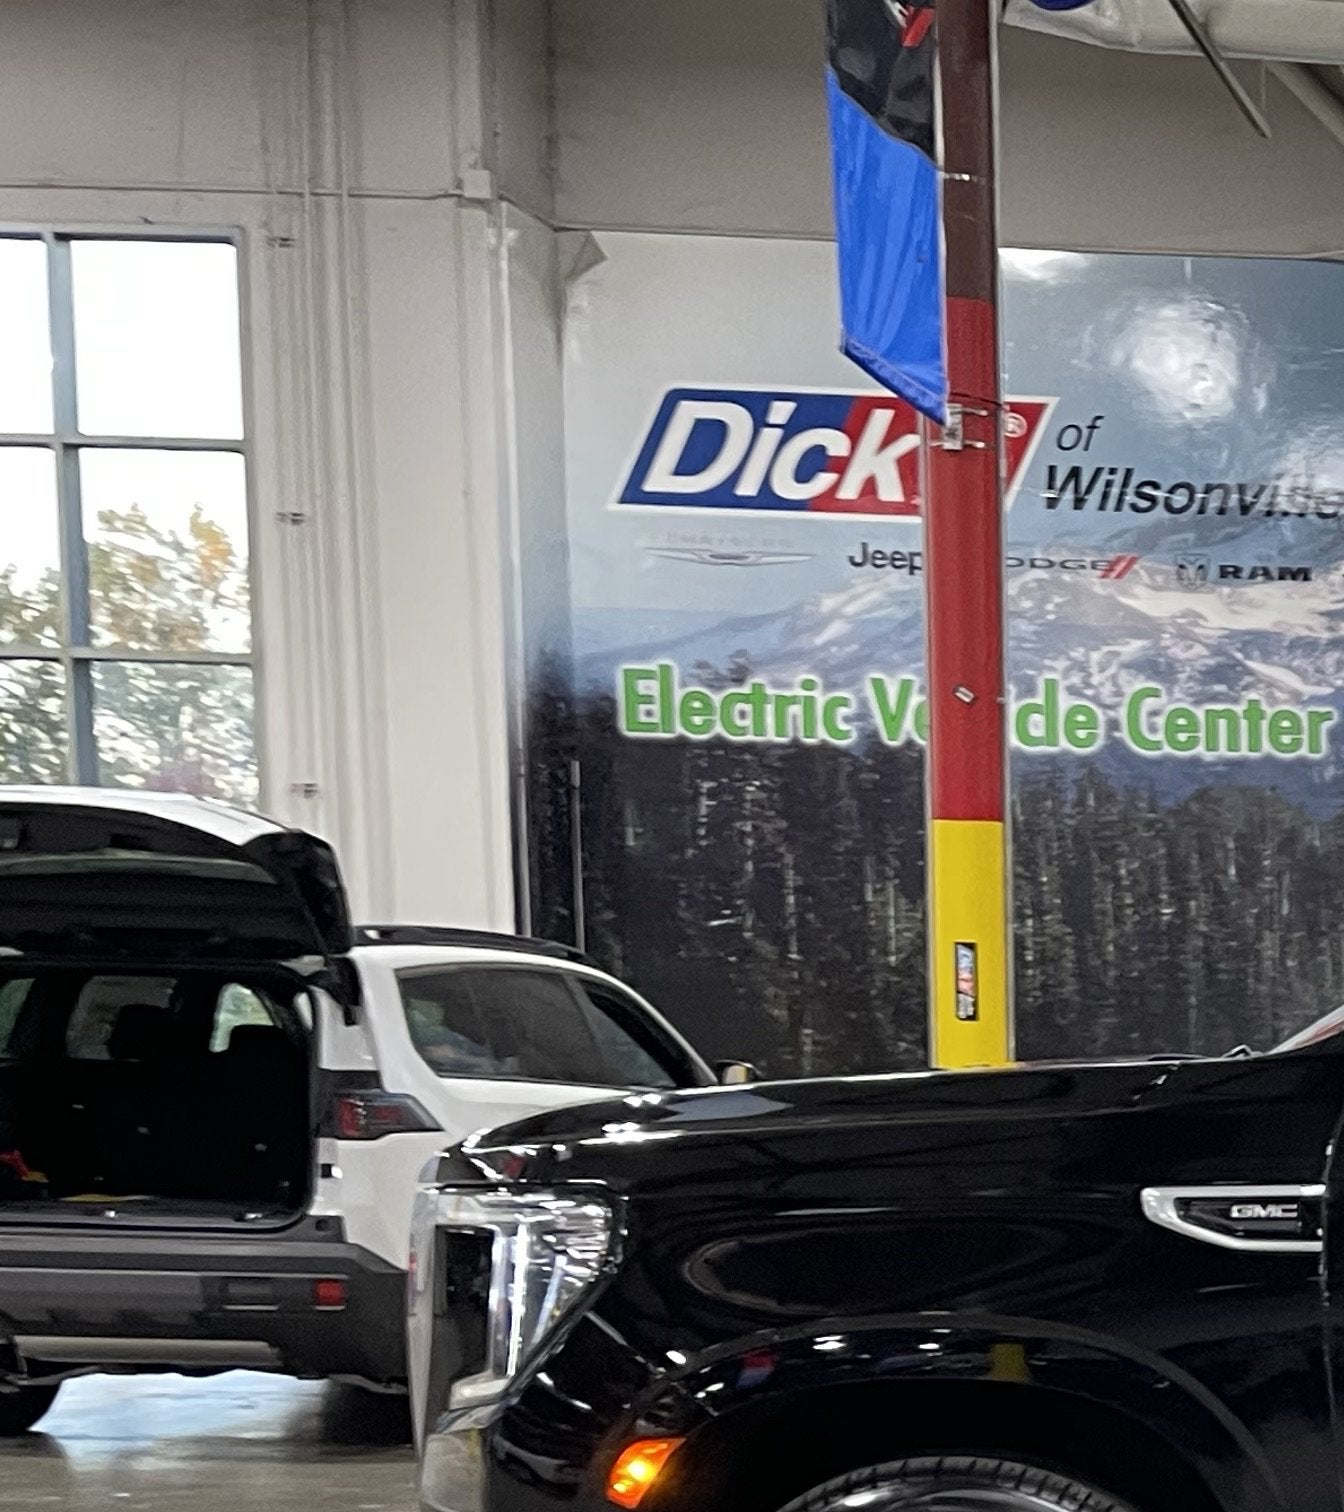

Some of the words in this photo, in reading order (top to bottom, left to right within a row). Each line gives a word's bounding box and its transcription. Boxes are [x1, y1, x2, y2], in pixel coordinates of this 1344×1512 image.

[641, 400, 923, 504] Dick
[1056, 415, 1105, 452] of
[1042, 464, 1344, 520] Wilsonvi
[1004, 555, 1115, 573] ODGE
[1217, 563, 1314, 582] RAM
[622, 663, 853, 741] Electric
[1126, 686, 1335, 754] Center
[1229, 1203, 1299, 1219] GMC
